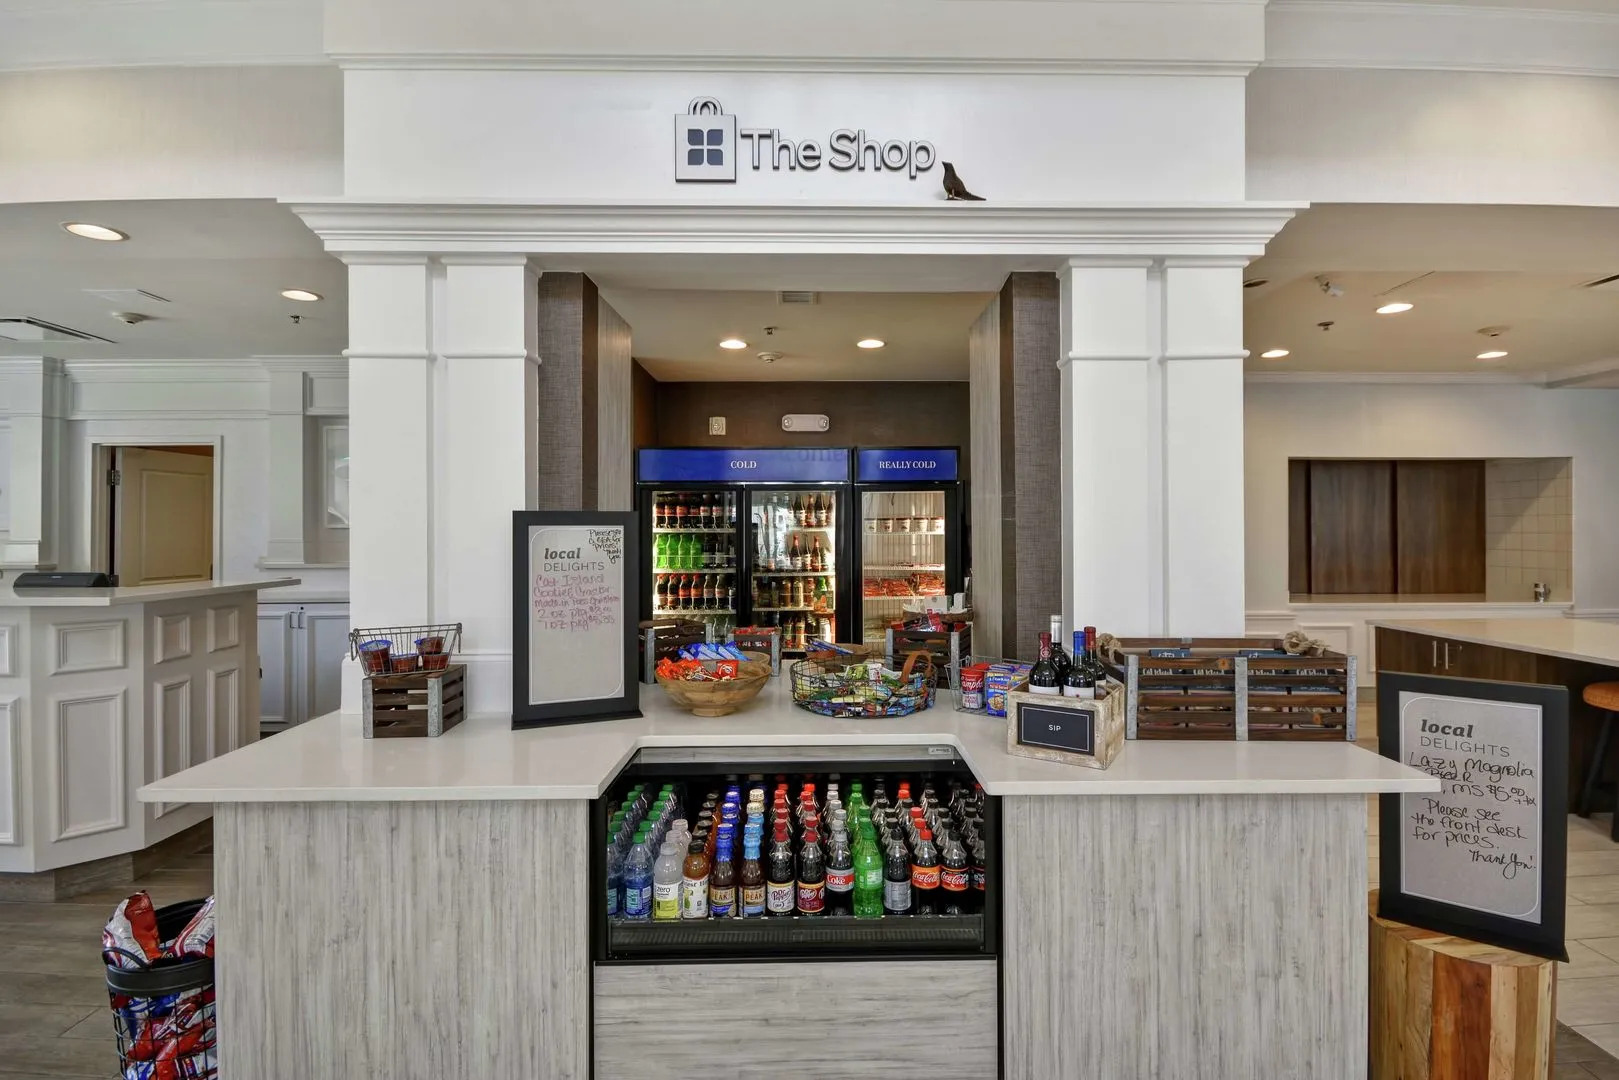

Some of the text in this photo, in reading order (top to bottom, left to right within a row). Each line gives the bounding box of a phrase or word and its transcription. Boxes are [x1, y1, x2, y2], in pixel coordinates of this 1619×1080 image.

[740, 128, 936, 180] The Shop
[730, 460, 757, 469] COLD
[879, 460, 937, 469] REALLY COLD
[544, 547, 581, 560] local
[543, 561, 605, 572] DELIGHTS
[1420, 719, 1474, 738] local
[1420, 736, 1510, 757] DELIGHTS
[1464, 758, 1535, 783] Magnolia
[1421, 797, 1501, 821] Please see
[1412, 825, 1440, 841] for
[1439, 815, 1480, 834] front
[1486, 823, 1528, 840] desk
